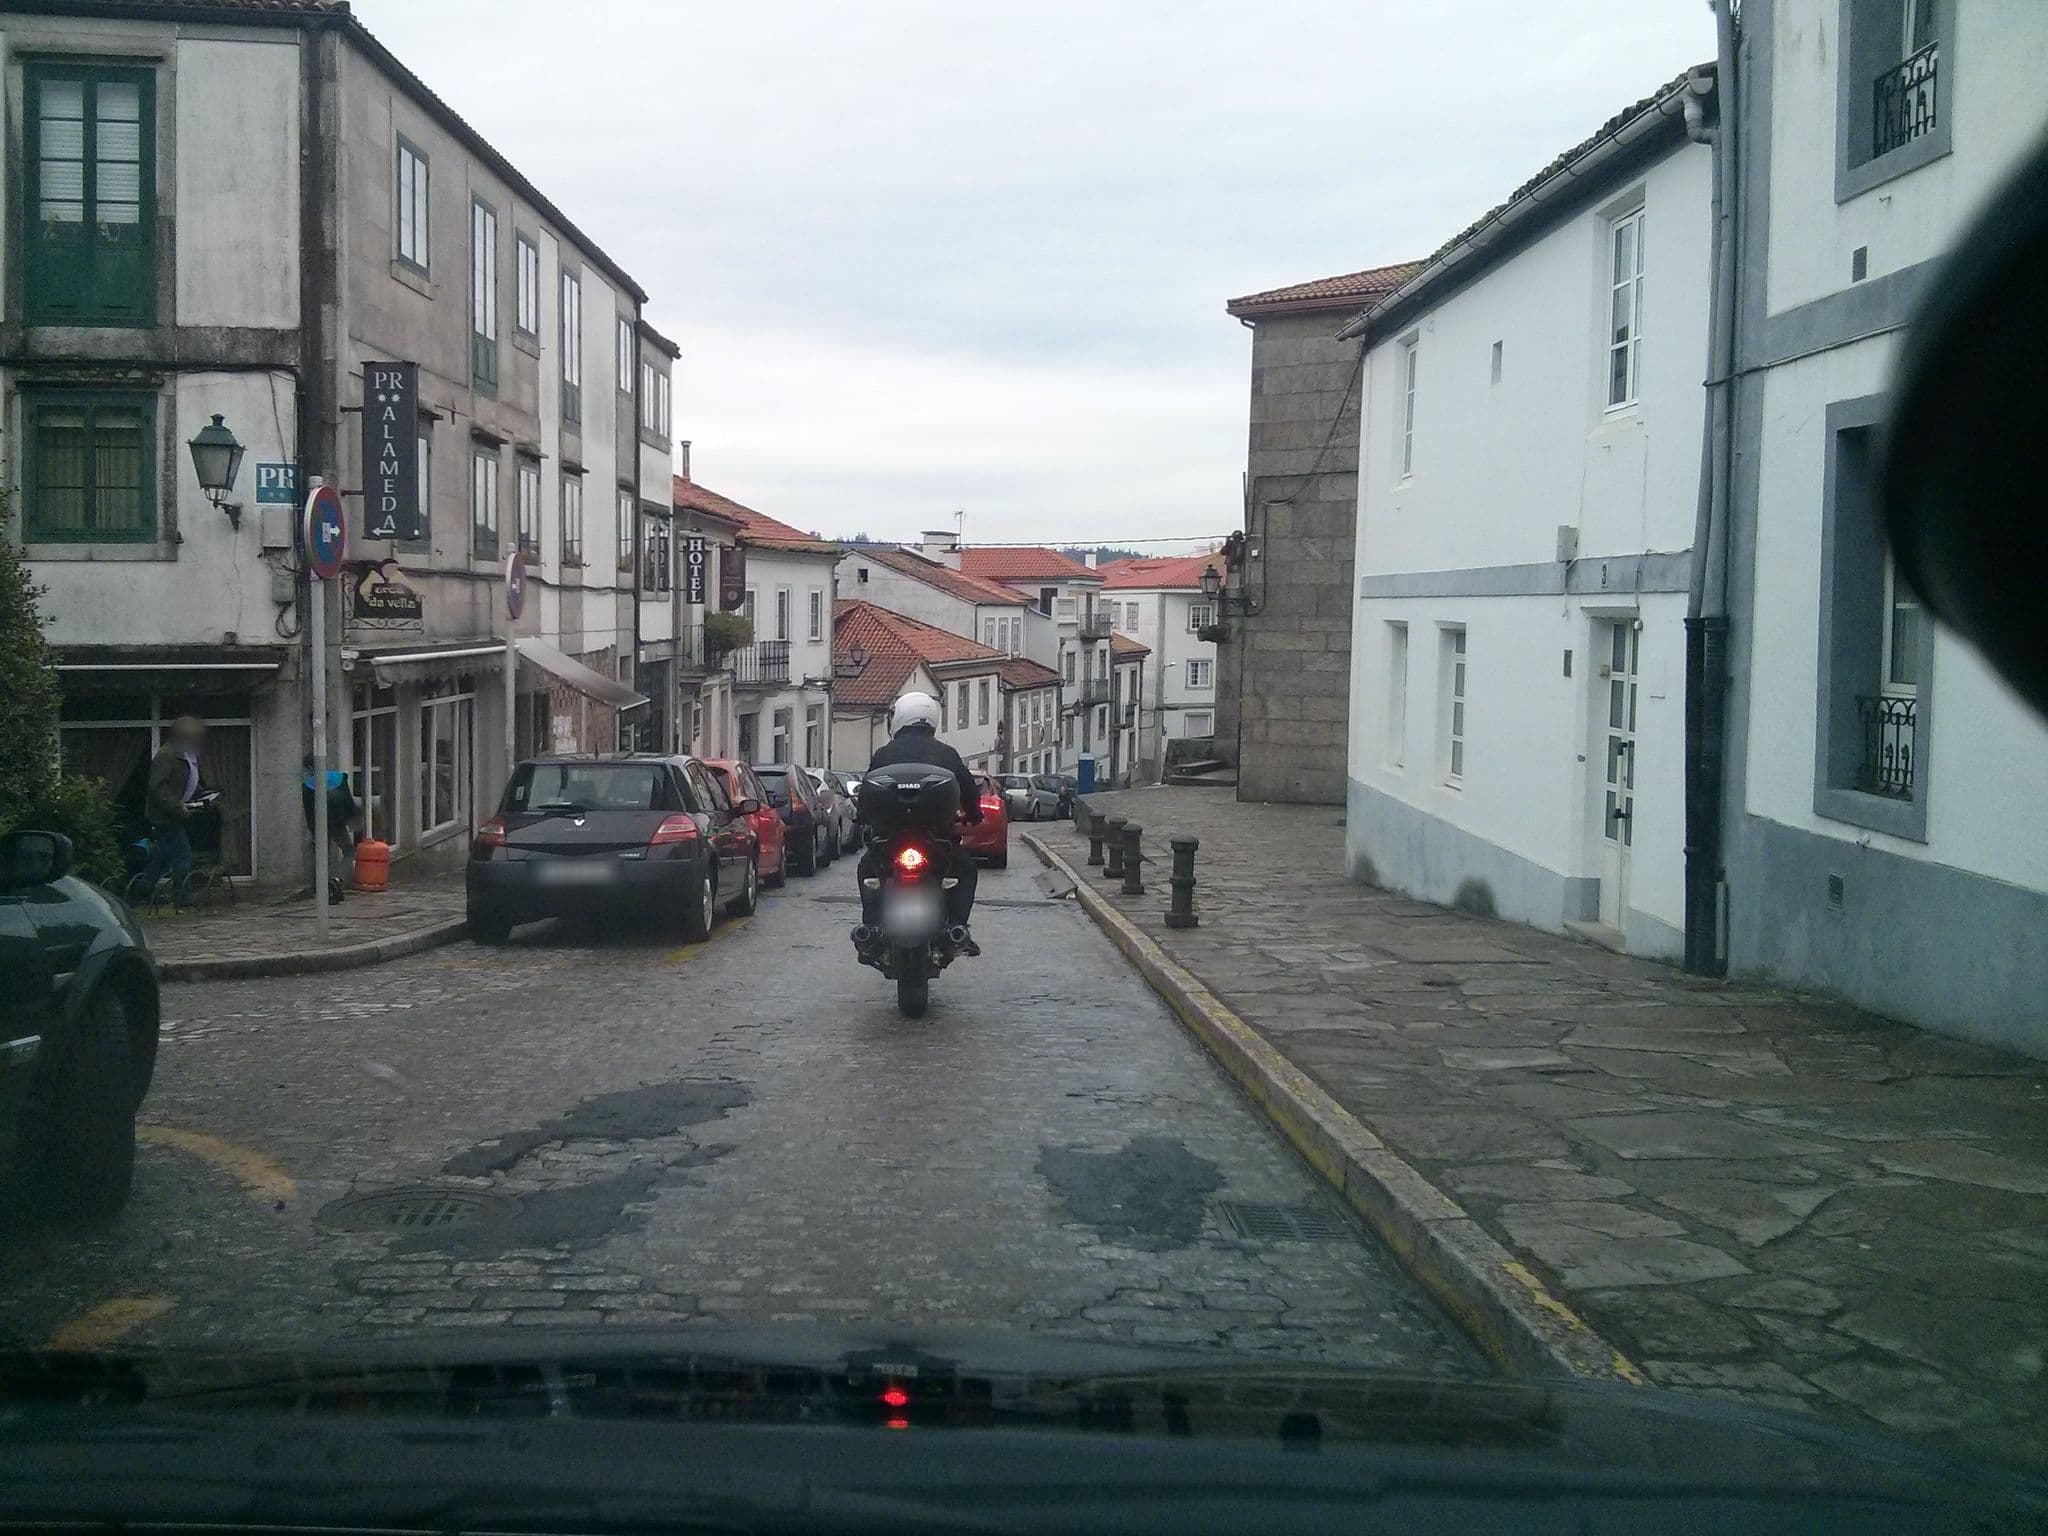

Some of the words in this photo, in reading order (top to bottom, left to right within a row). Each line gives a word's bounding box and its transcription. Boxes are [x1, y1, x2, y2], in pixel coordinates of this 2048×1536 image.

[374, 371, 404, 390] PR
[258, 467, 294, 489] PR
[380, 406, 399, 529] ALAMEDA
[689, 539, 703, 602] HOTEL
